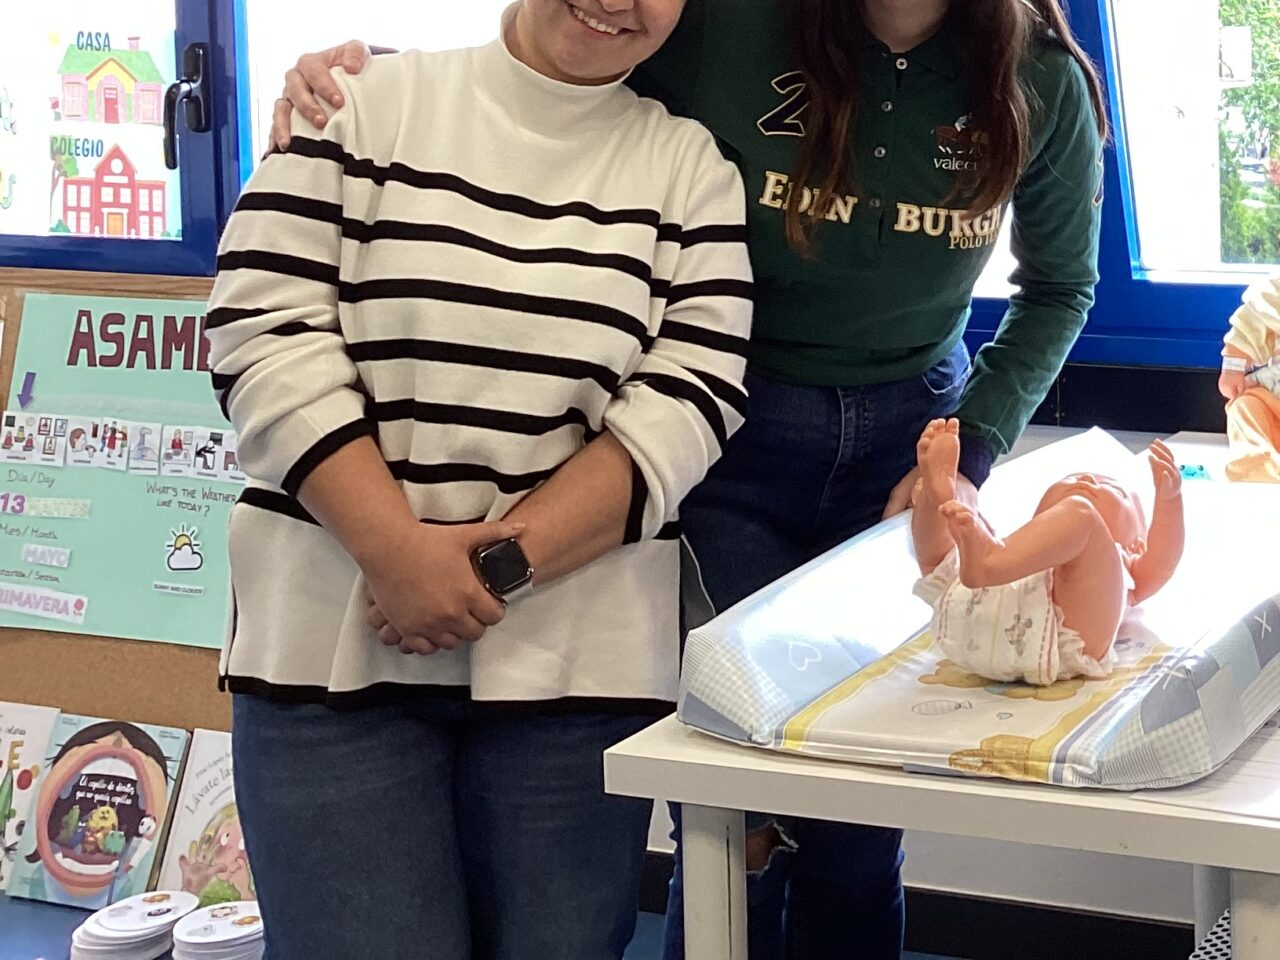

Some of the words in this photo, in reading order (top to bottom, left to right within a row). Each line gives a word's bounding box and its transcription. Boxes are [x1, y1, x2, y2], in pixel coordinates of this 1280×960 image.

[77, 31, 111, 52] CASA
[50, 137, 103, 157] COLEGIO
[0, 493, 26, 514] 13
